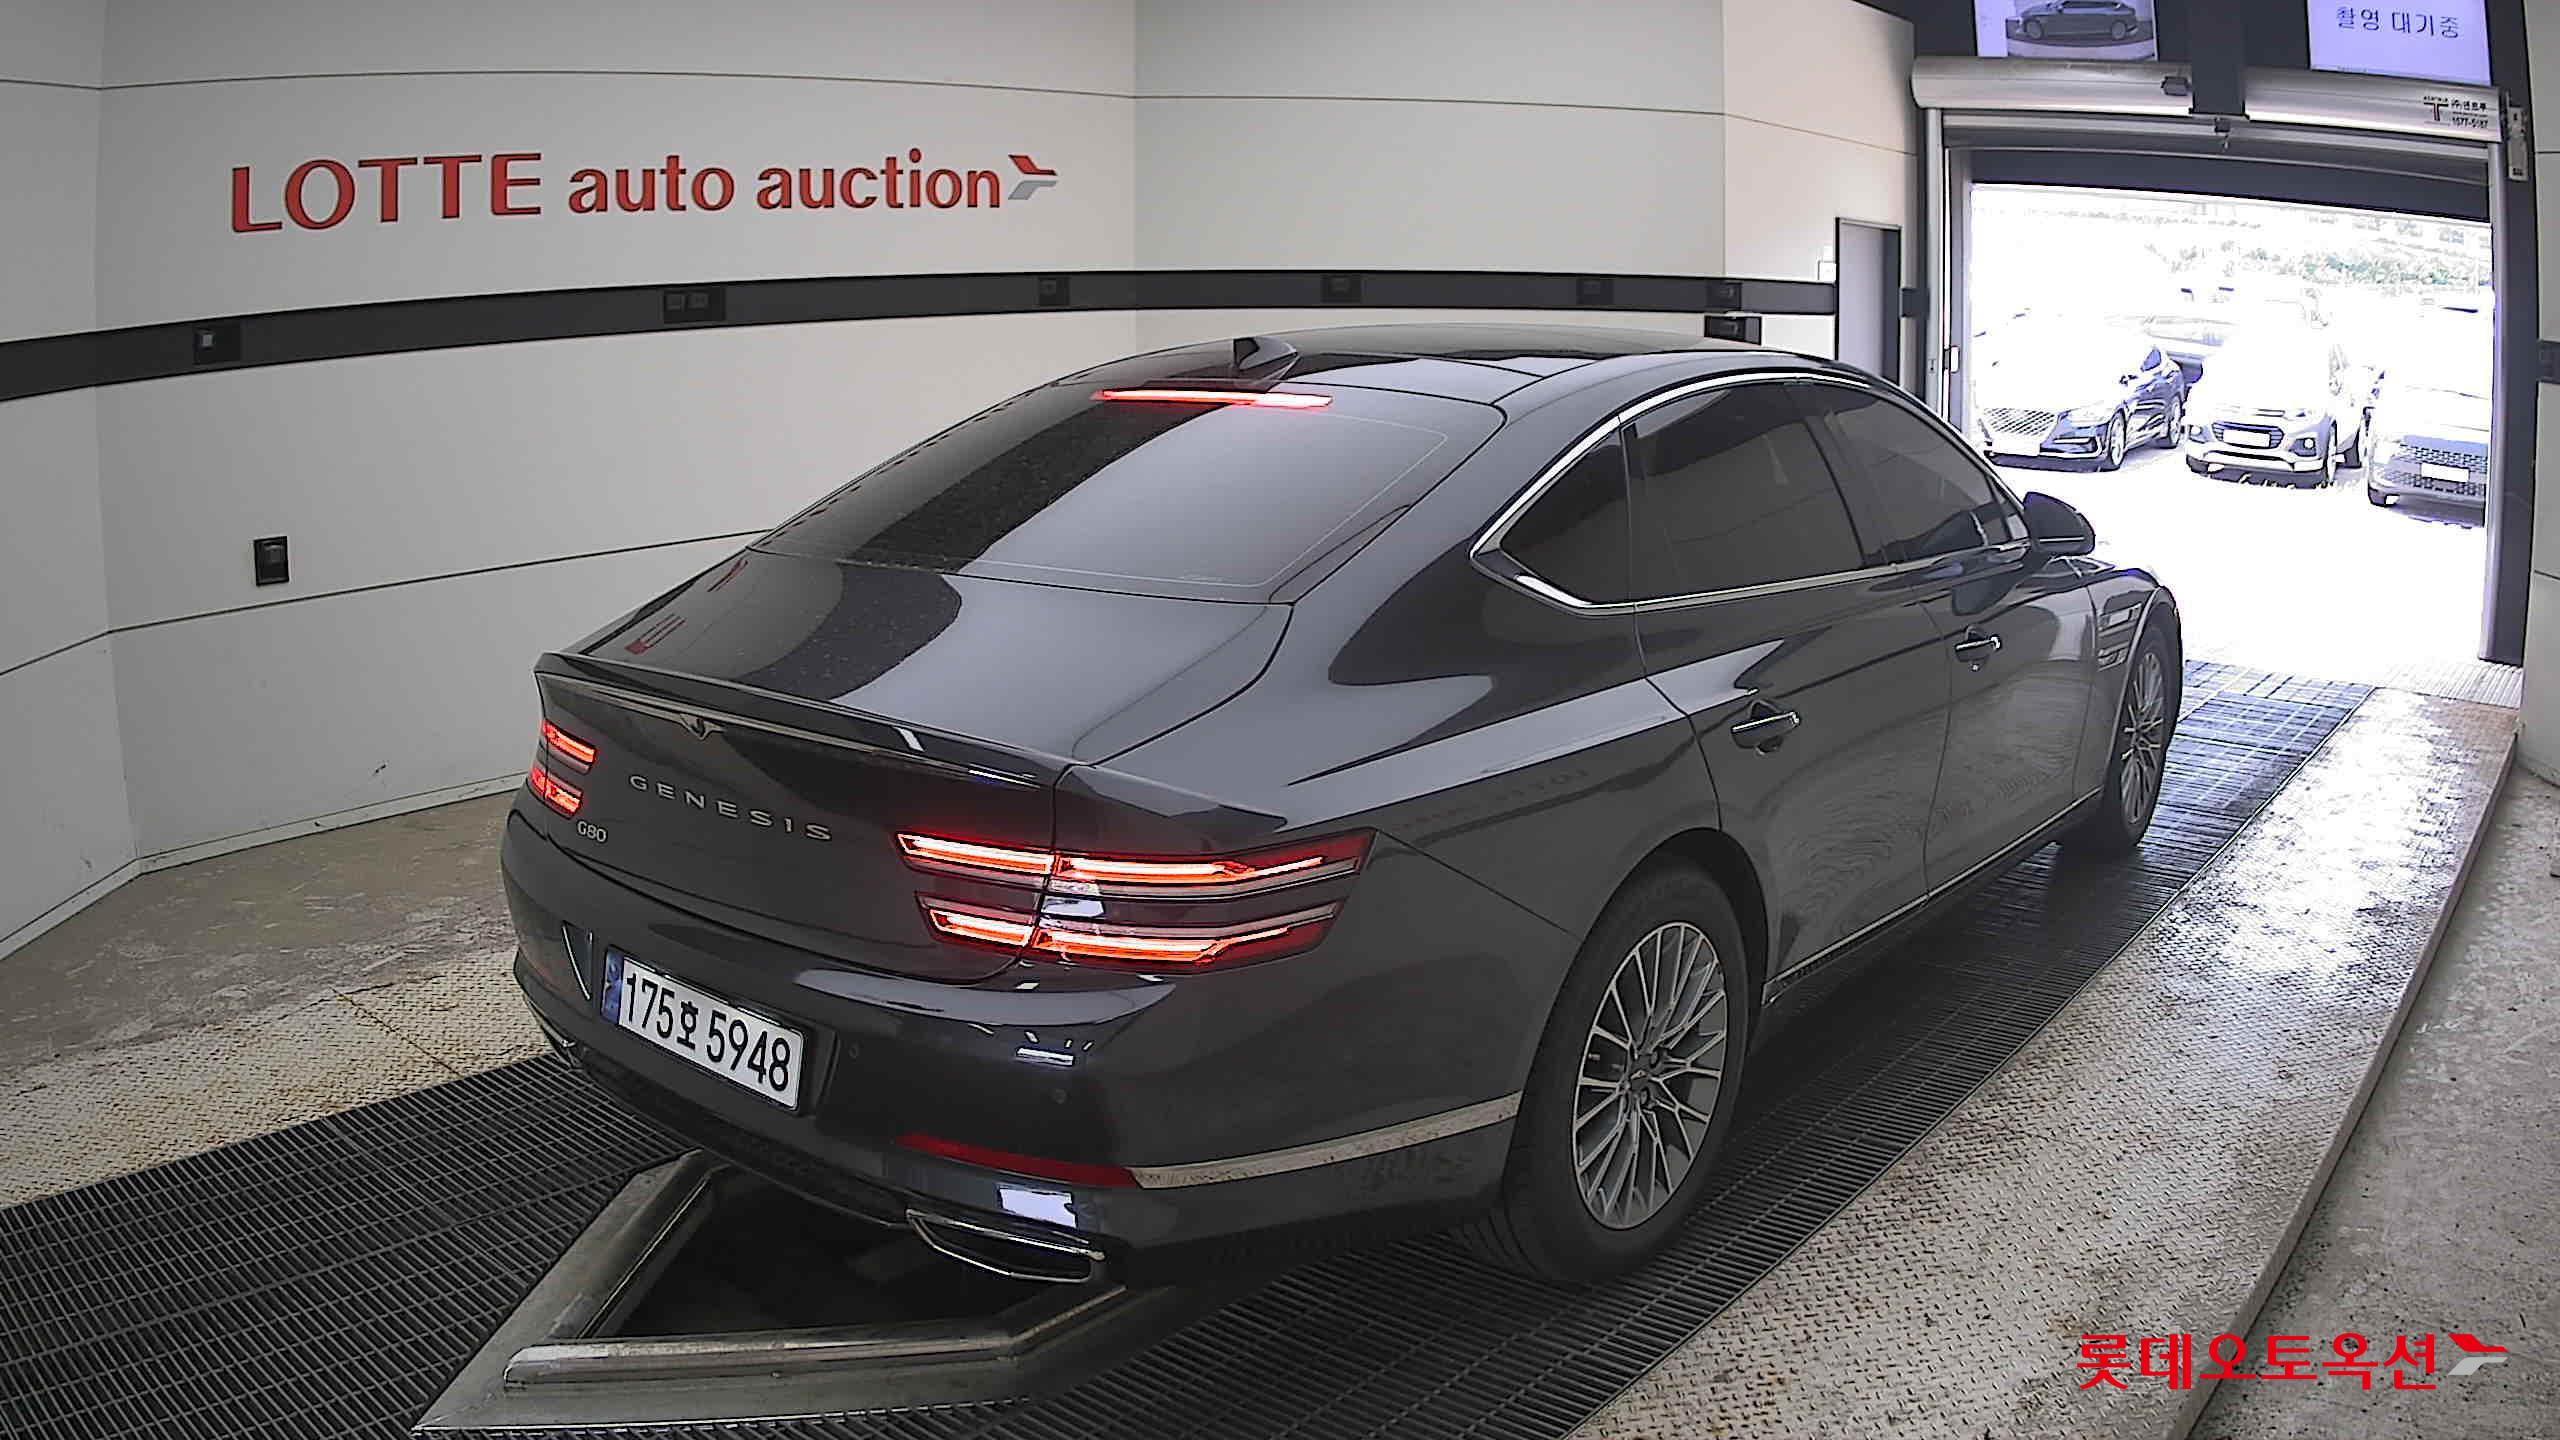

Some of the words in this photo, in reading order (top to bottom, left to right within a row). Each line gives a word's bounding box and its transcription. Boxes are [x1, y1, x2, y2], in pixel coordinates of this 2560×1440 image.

[2337, 6, 2380, 31] 촬영
[2391, 12, 2459, 39] 대기중
[232, 152, 539, 233] LOTTE
[568, 153, 737, 214] auto
[755, 148, 1004, 210] auction
[576, 819, 608, 843] G80
[629, 774, 832, 841] GENESIS
[626, 971, 699, 1051] 175호
[705, 1017, 792, 1093] 5948
